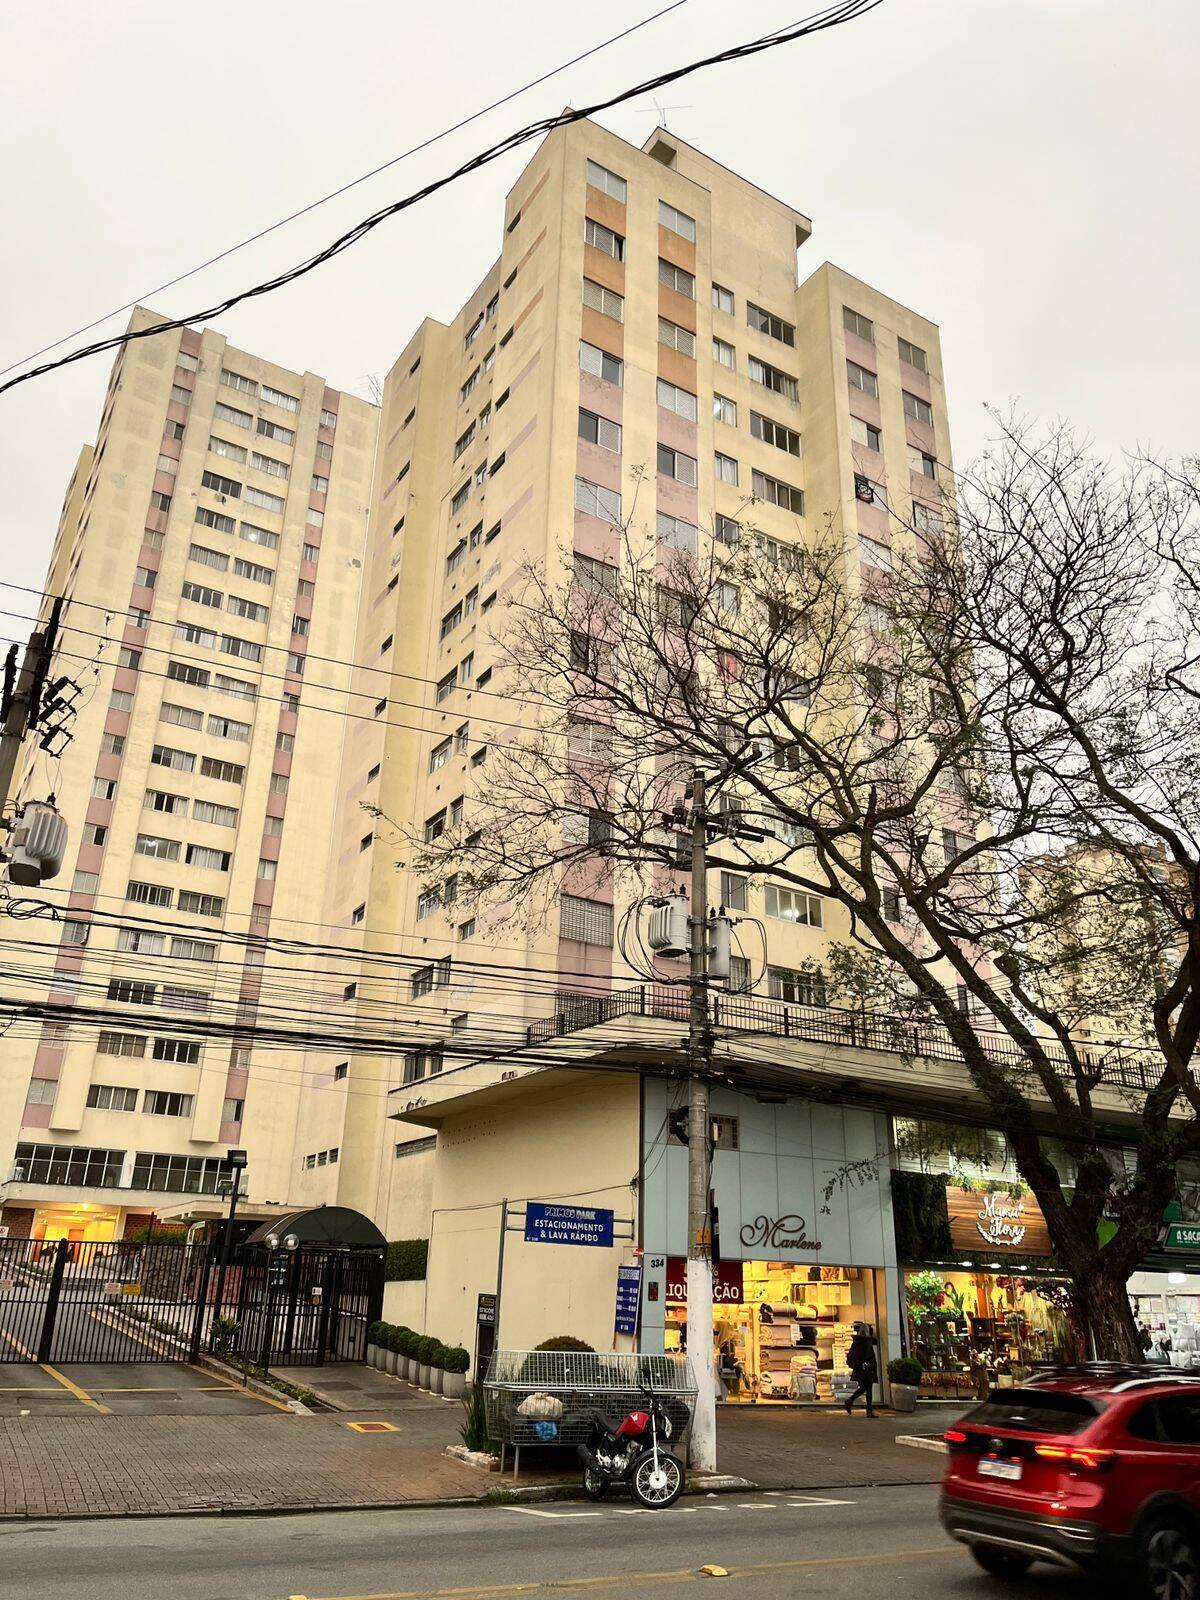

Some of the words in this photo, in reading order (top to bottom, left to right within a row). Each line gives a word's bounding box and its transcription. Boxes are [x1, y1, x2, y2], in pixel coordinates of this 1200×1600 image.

[576, 1209, 596, 1220] PARK
[534, 1219, 604, 1232] ESTACIONAMENTO
[540, 1229, 547, 1239] &
[548, 1231, 568, 1240] LAVA
[570, 1231, 599, 1242] RÁPIDO
[740, 1215, 822, 1251] Marlene
[651, 1259, 664, 1268] 334
